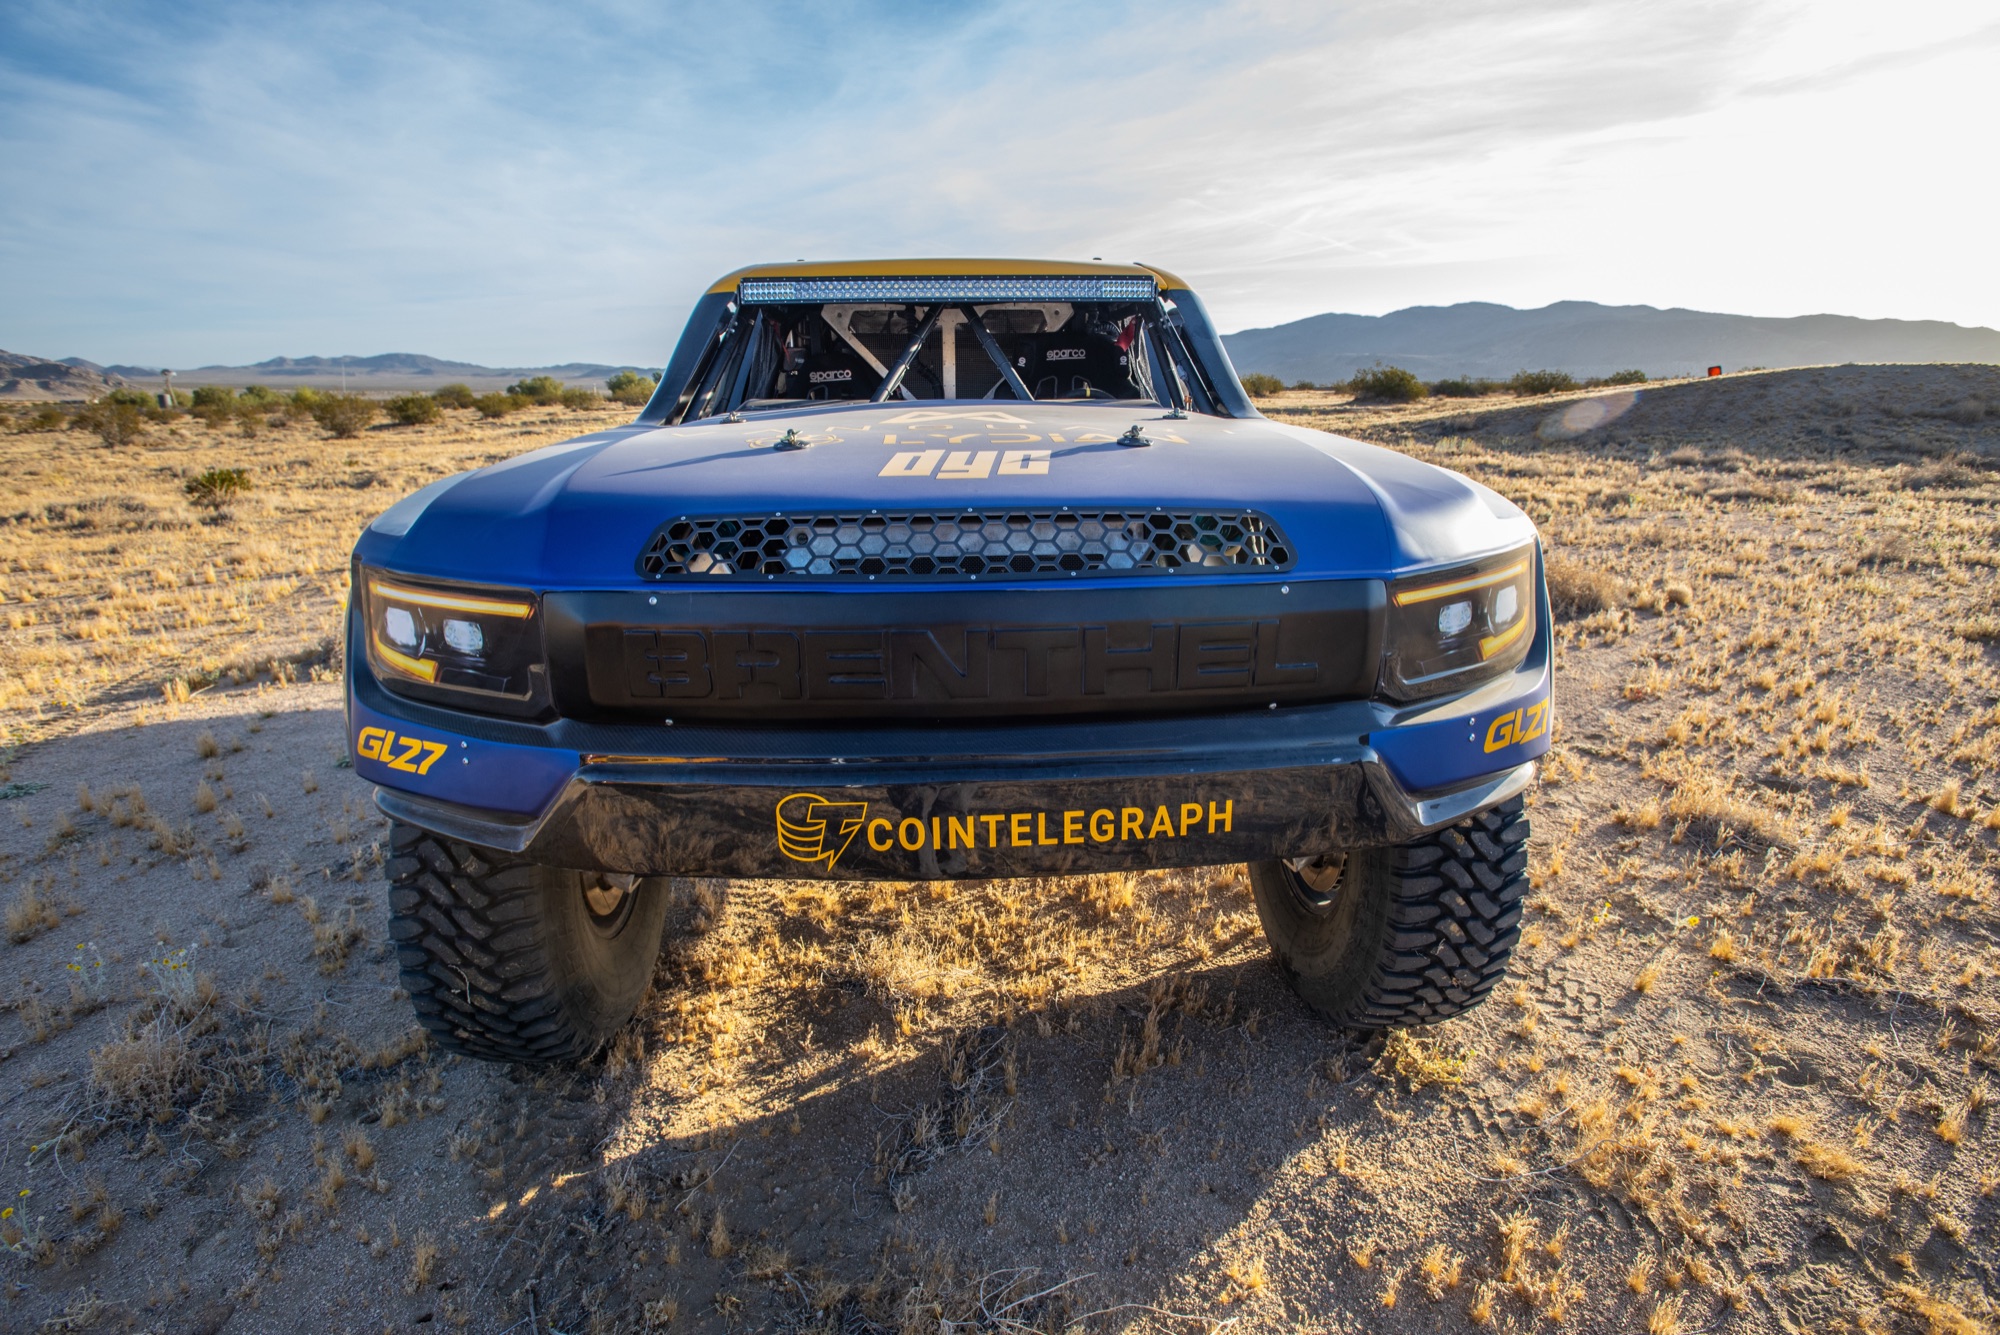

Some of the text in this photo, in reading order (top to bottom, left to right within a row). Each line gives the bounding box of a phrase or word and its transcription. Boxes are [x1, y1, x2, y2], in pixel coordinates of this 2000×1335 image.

[1046, 349, 1086, 361] sparco
[809, 369, 852, 383] sparco
[623, 619, 1319, 700] BRENTHEL
[867, 799, 1233, 852] COINTELEGRAPH
